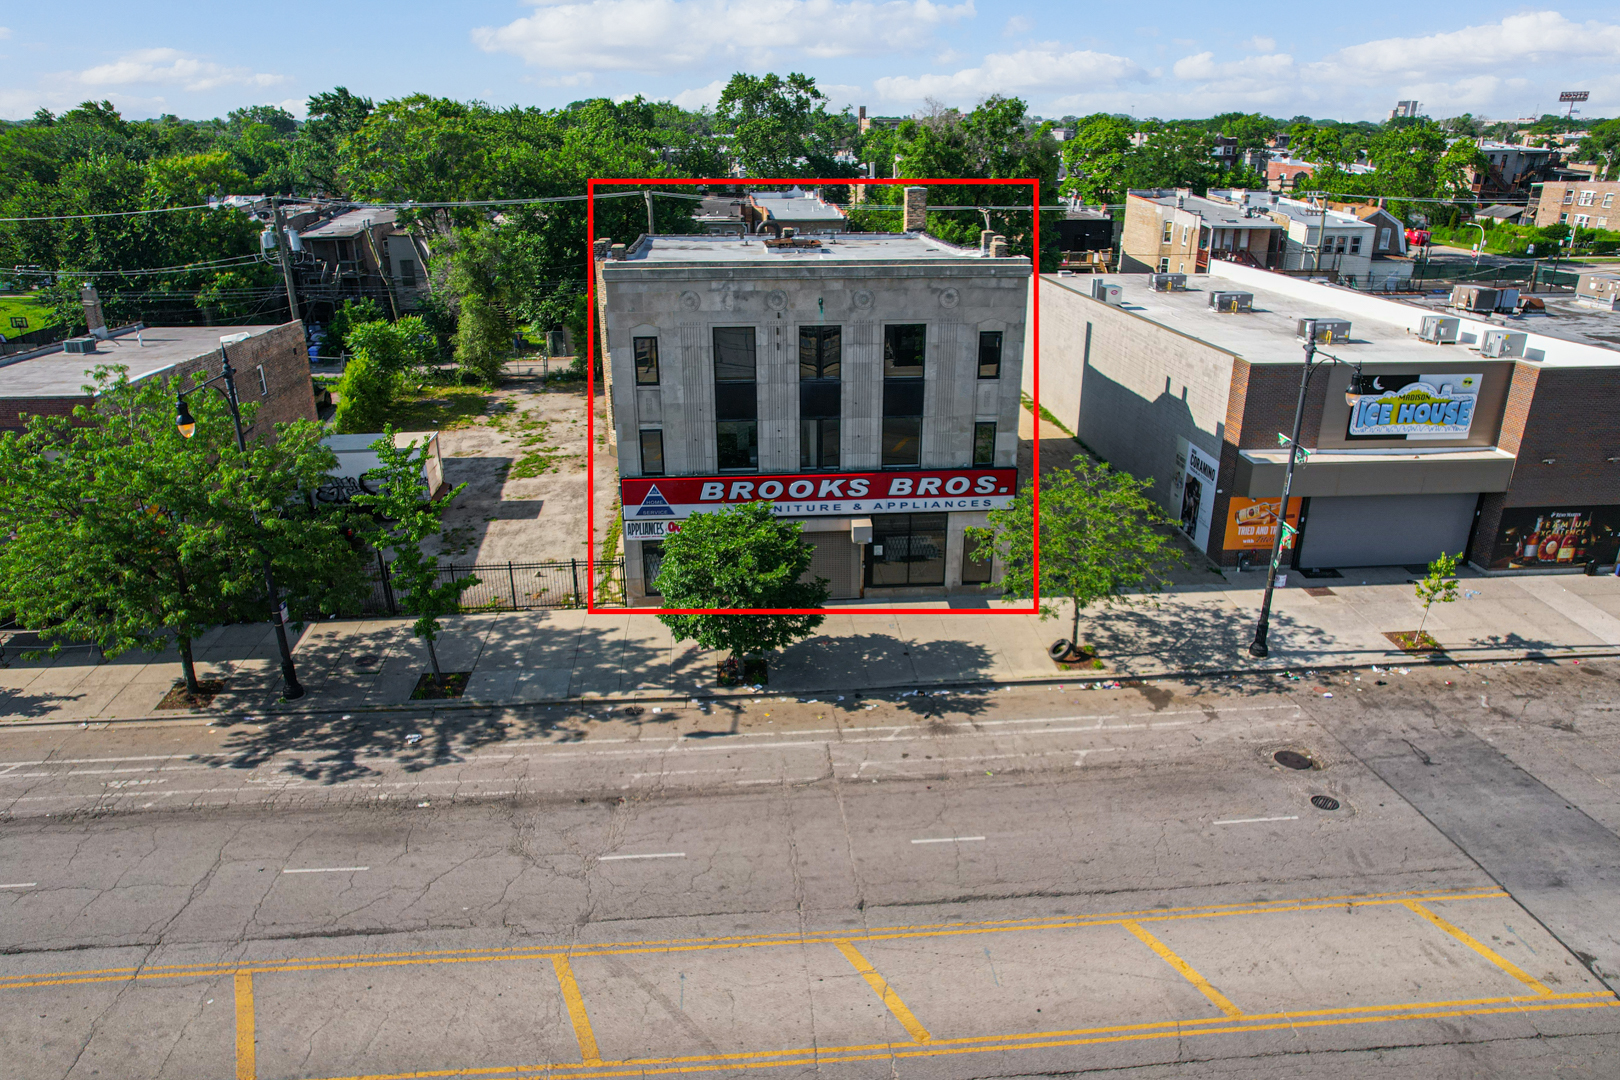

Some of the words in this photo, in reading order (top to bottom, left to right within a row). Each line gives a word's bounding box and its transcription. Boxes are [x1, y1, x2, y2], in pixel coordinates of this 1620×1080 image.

[1398, 393, 1431, 401] MADISON
[1356, 401, 1394, 428] ICE
[1397, 399, 1474, 427] HOUSE
[699, 478, 871, 501] BROOKS
[888, 475, 1009, 497] BROS.
[853, 503, 862, 511] &
[873, 499, 992, 510] APPLIANCES
[627, 521, 665, 536] APPLIANCES
[1238, 526, 1255, 535] TRIED
[1256, 526, 1269, 535] AND
[1539, 520, 1569, 529] TEAM
[1575, 520, 1589, 528] UP
